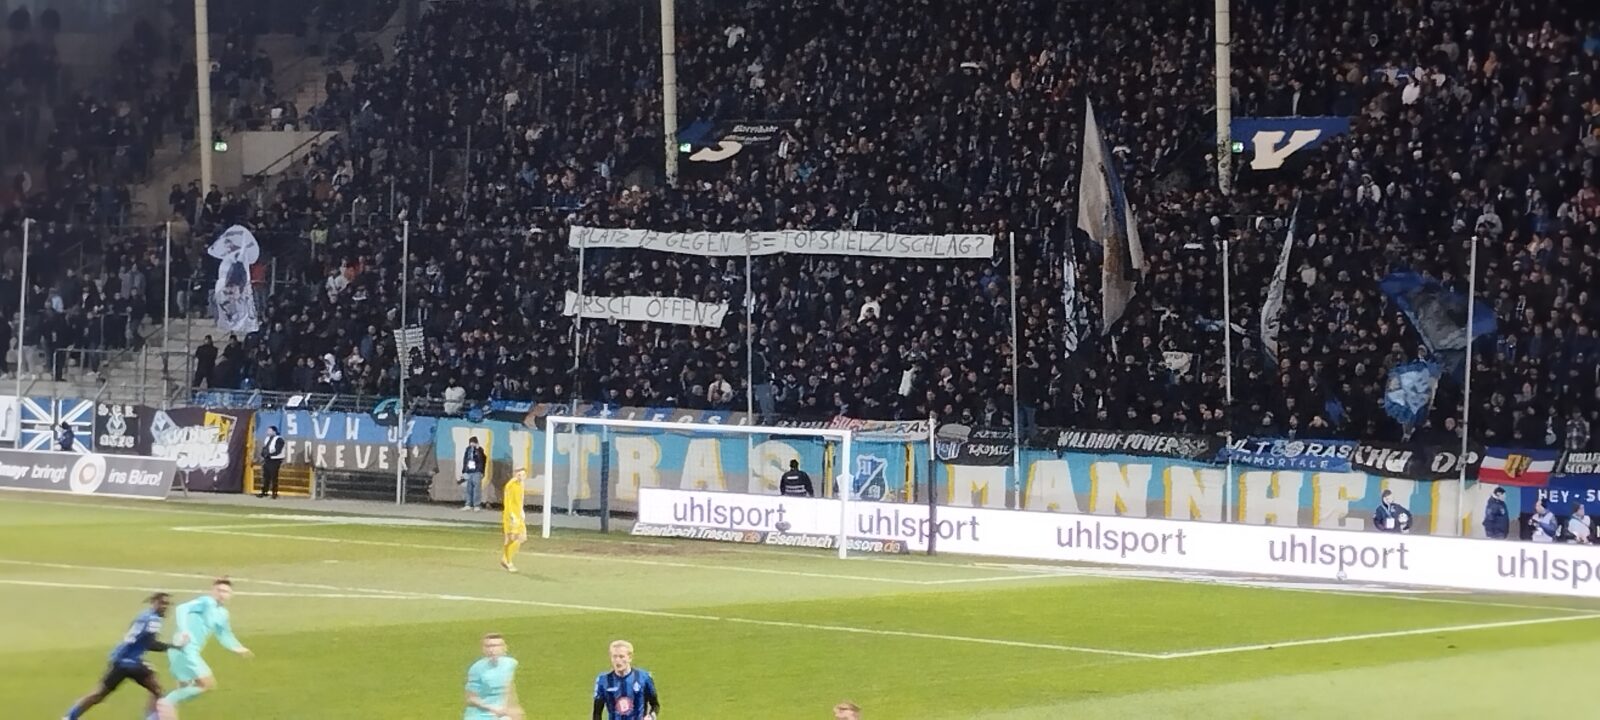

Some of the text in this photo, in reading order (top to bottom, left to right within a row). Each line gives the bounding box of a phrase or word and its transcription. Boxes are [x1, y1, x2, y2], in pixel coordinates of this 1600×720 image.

[577, 229, 629, 244] PLATZ
[665, 233, 731, 252] GEGEN
[781, 231, 985, 256] TOPSPIELZUSCHLAG?
[571, 296, 721, 325] ARSCH OFFEN?
[31, 464, 67, 483] bringt
[108, 470, 126, 485] ins
[128, 469, 163, 487] Büro!
[1538, 489, 1569, 503] HEY
[673, 497, 787, 529] uhlsport
[858, 508, 980, 544] uhlsport
[632, 523, 697, 538] Eisenbach
[765, 532, 832, 549] Eisenbach
[1056, 520, 1187, 557] uhlsport
[1269, 534, 1409, 571] uhlsport
